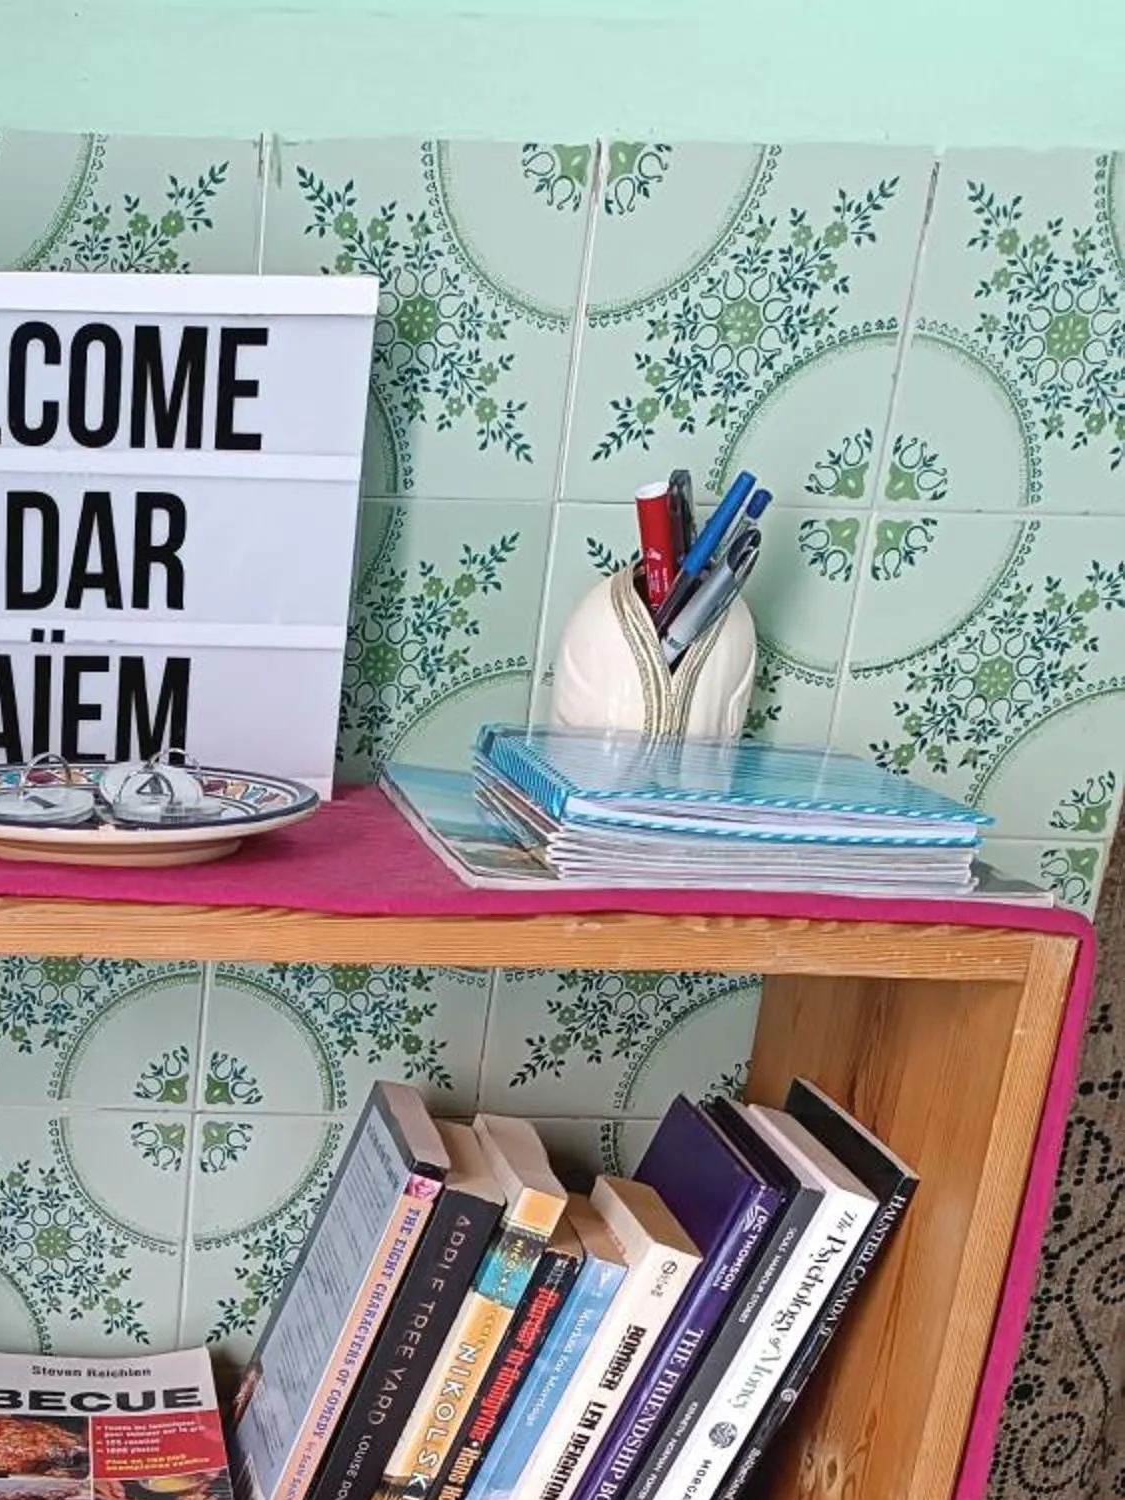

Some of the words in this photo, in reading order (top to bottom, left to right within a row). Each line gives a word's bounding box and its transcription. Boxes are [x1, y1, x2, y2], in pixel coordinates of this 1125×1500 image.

[5, 491, 188, 611] DAR
[398, 1205, 421, 1237] THE
[834, 1208, 858, 1235] The
[859, 1192, 907, 1264] HAUNTED
[379, 1236, 407, 1280] EIGHT
[718, 1231, 757, 1293] THOMSON
[769, 1227, 847, 1337] Psychology
[342, 1280, 388, 1366] CHARACTERS
[824, 1263, 866, 1324] CANADA
[395, 1295, 435, 1360] TREE
[597, 1321, 647, 1393] BOMBER
[668, 1323, 703, 1370] THE
[31, 1365, 82, 1378] Steven
[333, 1366, 352, 1385] OF
[365, 1362, 405, 1427] YARD
[726, 1344, 781, 1416] Money
[310, 1386, 342, 1439] COMEDY
[576, 1398, 606, 1433] LEN
[607, 1366, 679, 1480] FRIENDSHIP
[345, 1431, 373, 1477] LOUISE
[448, 1444, 480, 1486] Hans
